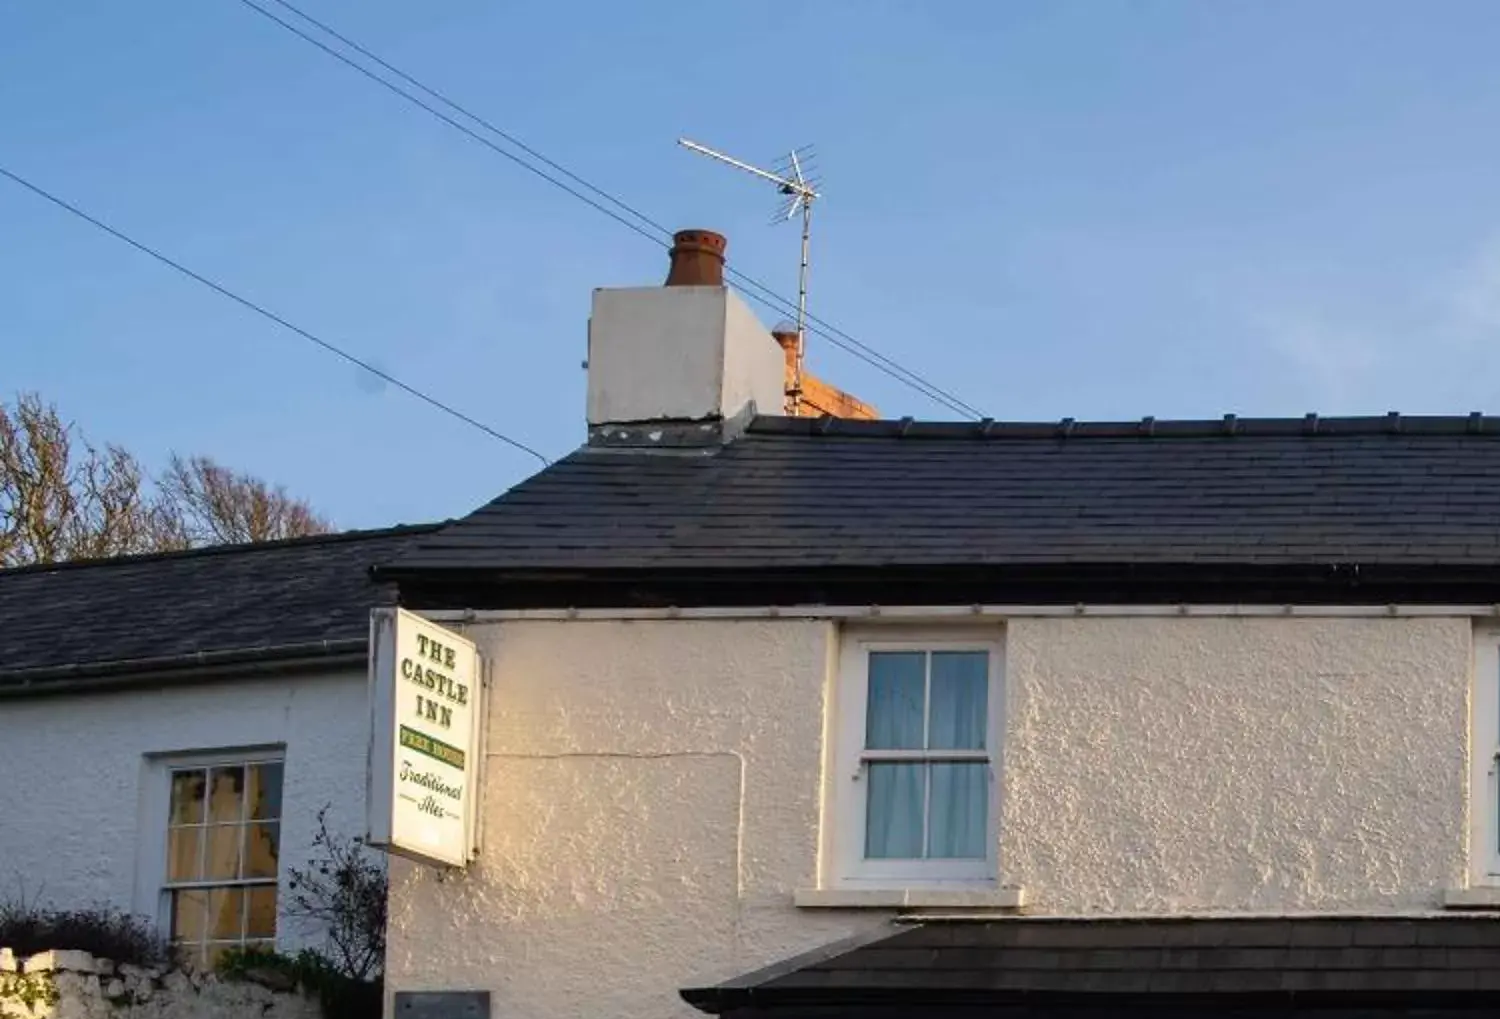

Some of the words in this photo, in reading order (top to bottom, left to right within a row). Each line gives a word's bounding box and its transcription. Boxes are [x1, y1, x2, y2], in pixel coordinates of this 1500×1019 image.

[417, 633, 456, 669] THE
[401, 658, 468, 705] CASTLE
[416, 695, 453, 729] INN
[399, 760, 463, 801] Traditional
[417, 796, 445, 818] Ales
